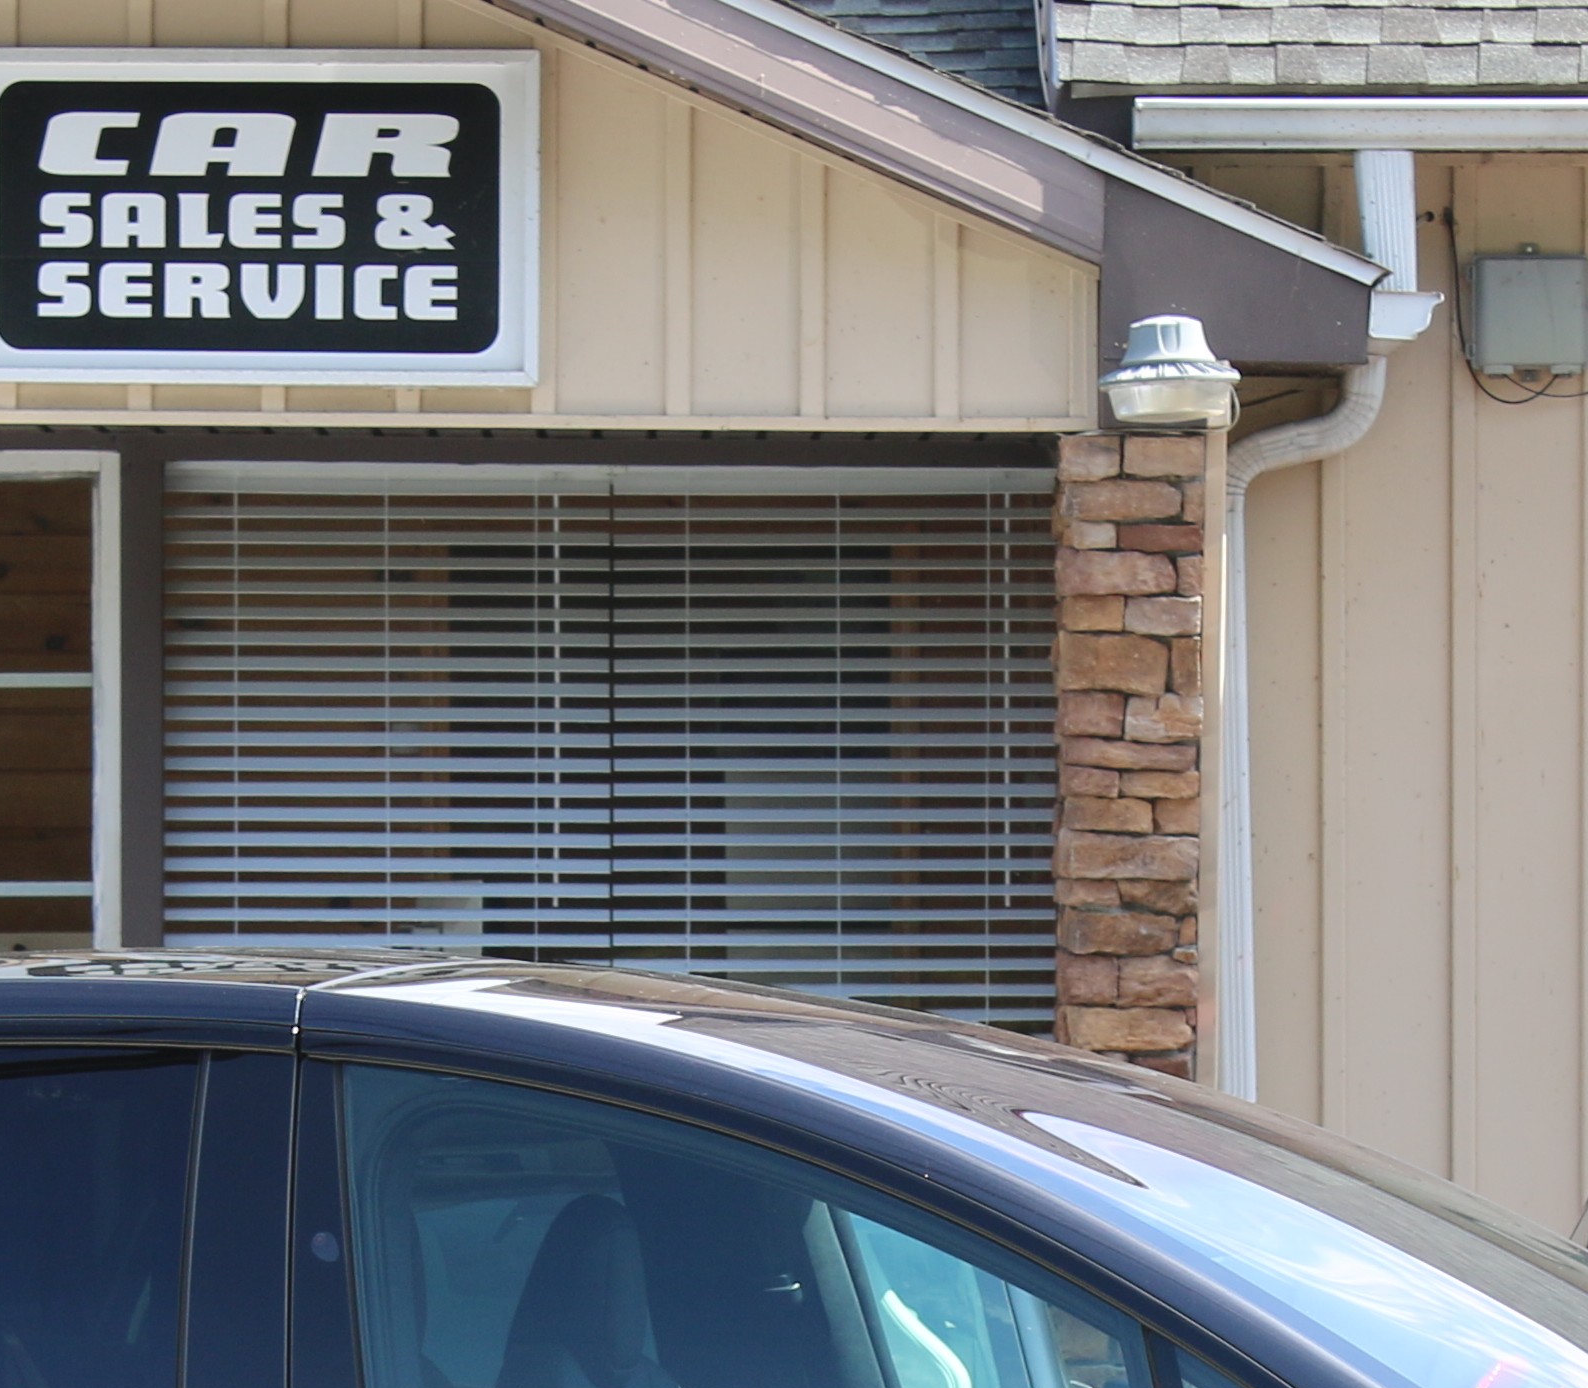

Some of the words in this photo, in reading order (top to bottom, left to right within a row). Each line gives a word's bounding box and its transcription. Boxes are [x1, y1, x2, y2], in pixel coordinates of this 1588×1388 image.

[38, 111, 460, 178] CAR
[39, 192, 346, 249] SALES
[374, 194, 456, 250] &
[37, 261, 458, 321] SERVICE
